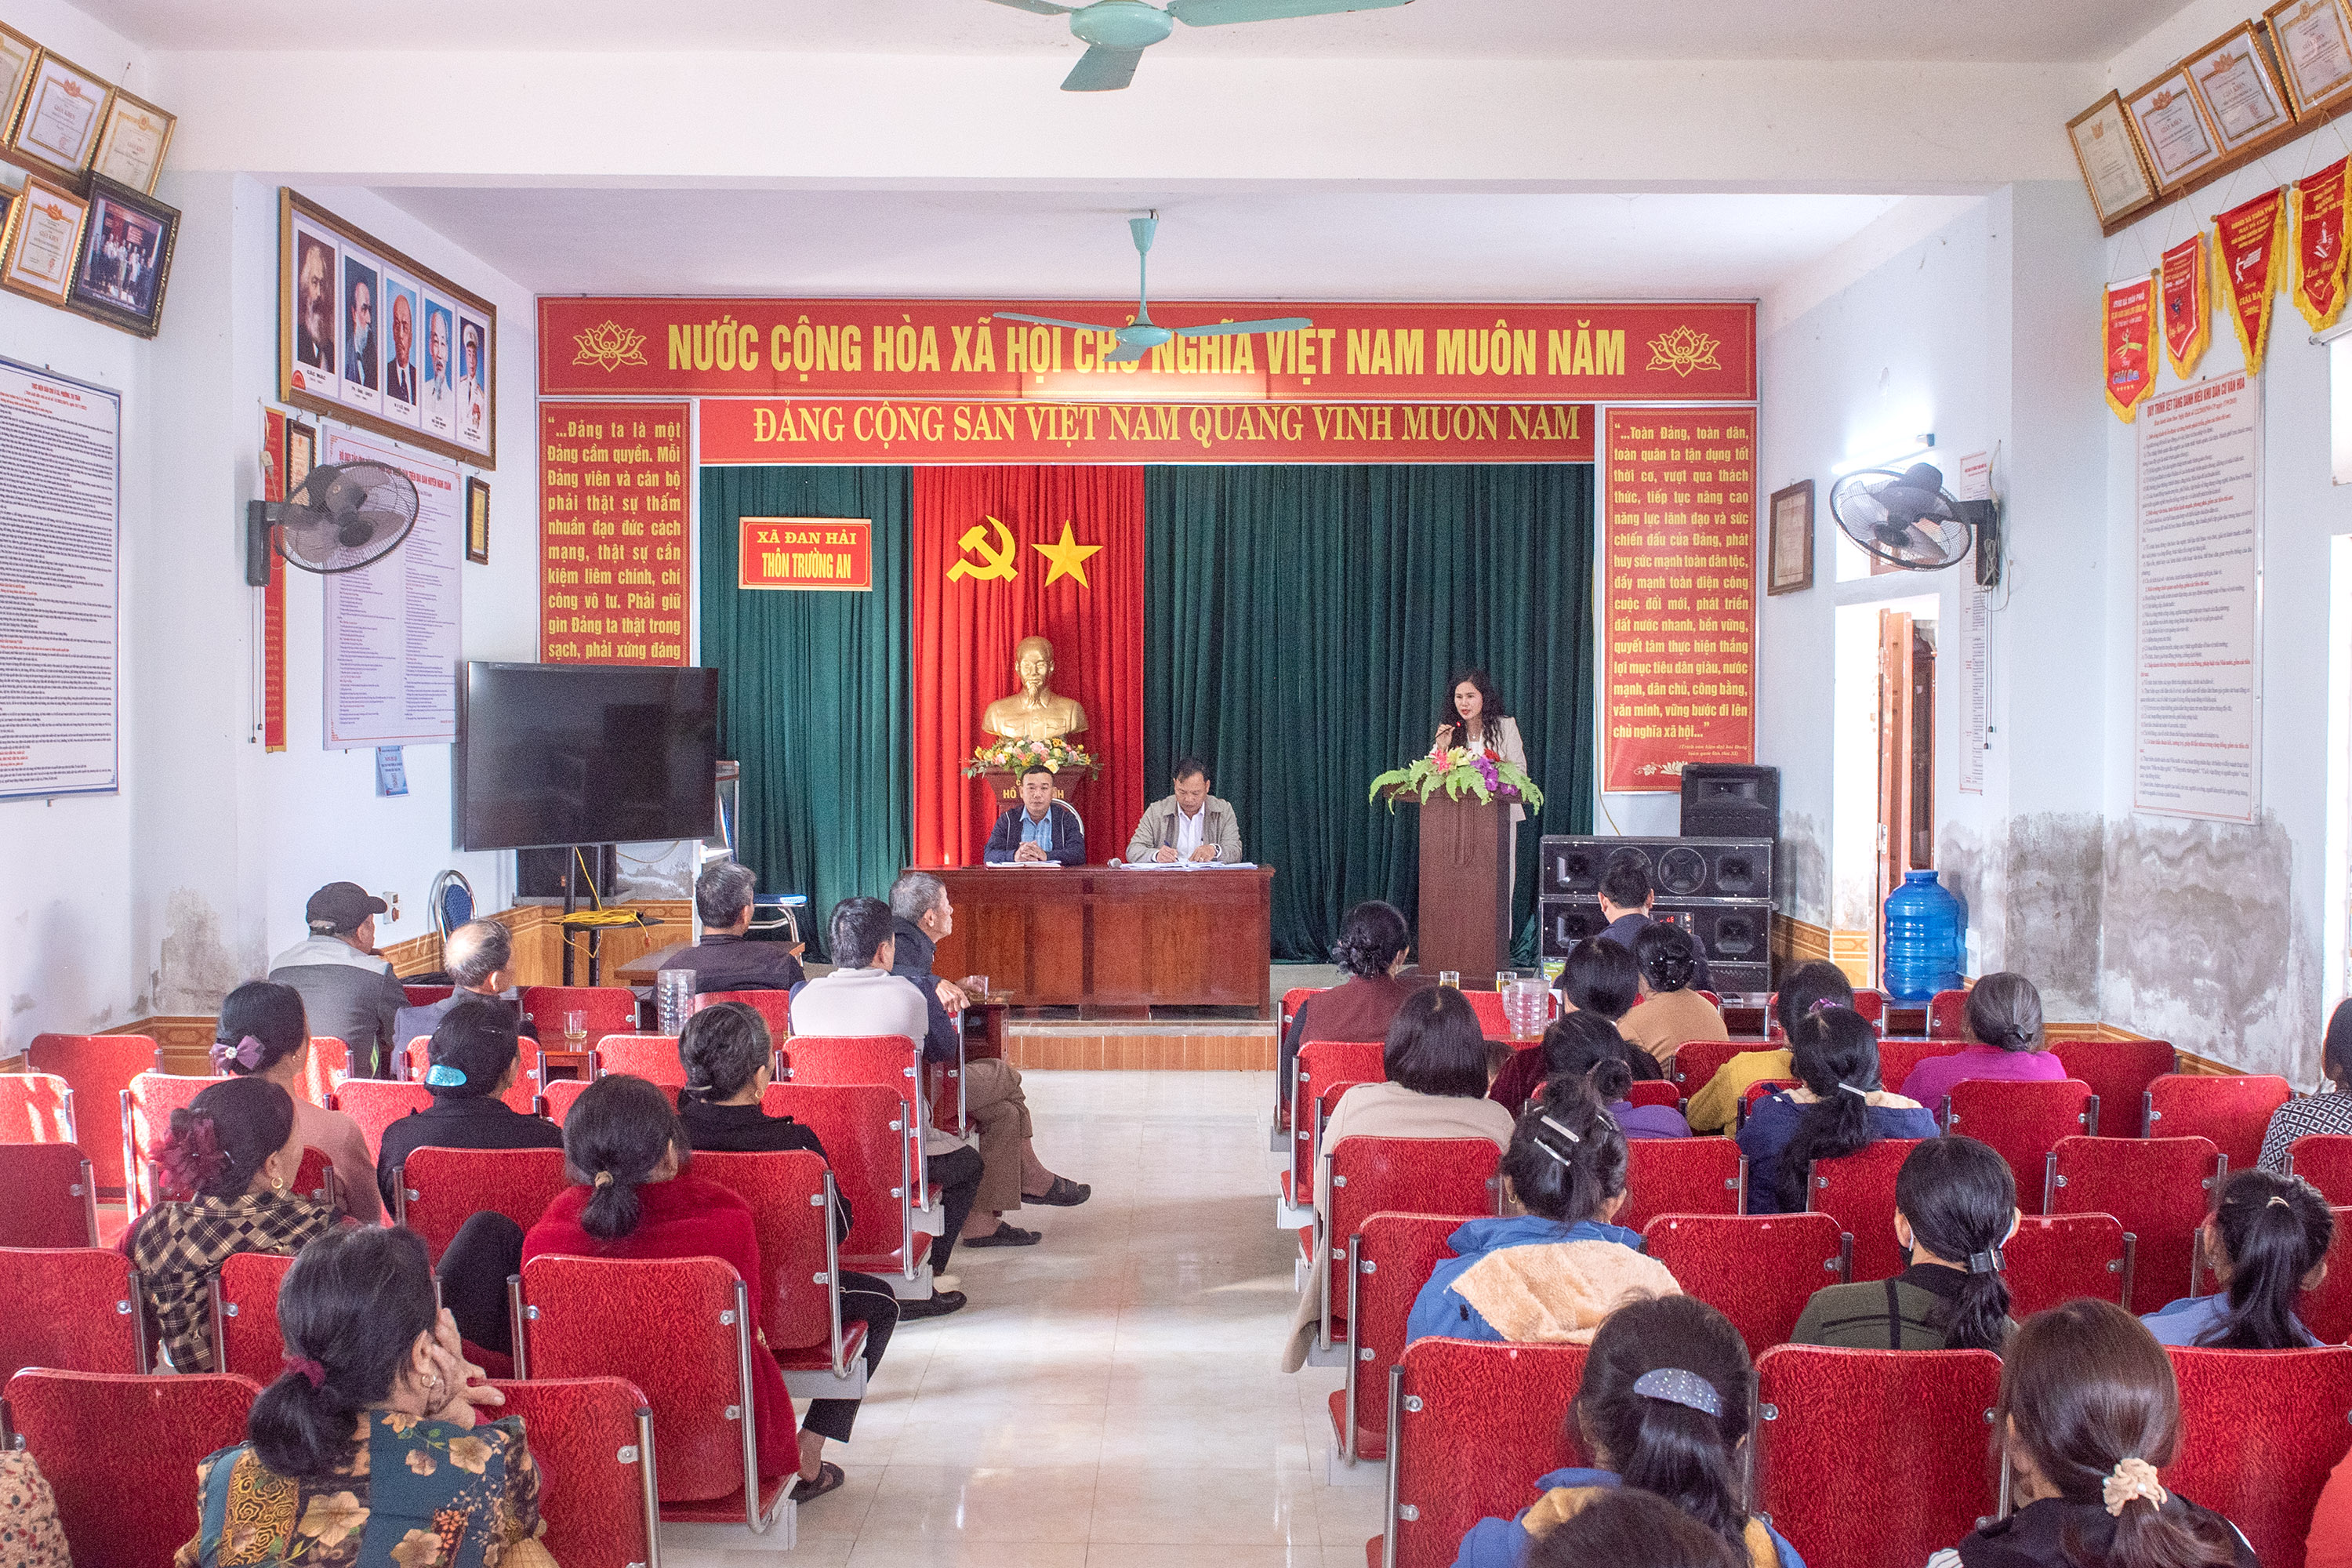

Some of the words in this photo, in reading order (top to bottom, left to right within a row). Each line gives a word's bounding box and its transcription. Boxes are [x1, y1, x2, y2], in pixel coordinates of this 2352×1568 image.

[669, 315, 759, 372] NƯỚC
[771, 316, 862, 382] CỘNG
[873, 315, 940, 372] HÒA
[951, 317, 996, 372] XÃ
[1007, 322, 1061, 383] HỘI
[1266, 323, 1336, 385] VIỆT
[1346, 328, 1425, 376] NAM
[1436, 320, 1537, 376] MUÔN
[1548, 319, 1625, 376] NĂM
[612, 422, 624, 437] ta
[633, 422, 646, 437] là
[655, 422, 681, 441] một
[753, 400, 845, 442] ĐẢNG
[854, 401, 945, 449] CỘNG
[1109, 406, 1181, 441] NAM
[1189, 406, 1304, 448] QUANG
[1312, 406, 1393, 441] VINH
[1661, 426, 1690, 440] Đảng,
[1697, 426, 1719, 439] toàn
[1726, 426, 1749, 440] dân,
[548, 444, 578, 463] Đảng
[583, 444, 608, 462] cầm
[613, 444, 652, 464] quyền.
[657, 443, 680, 462] Mỗi
[1614, 448, 1636, 460] toàn
[1641, 448, 1666, 462] quân
[1671, 449, 1680, 460] ta
[1686, 448, 1700, 463] tận
[1706, 448, 1730, 463] dụng
[1735, 445, 1749, 460] tốt
[548, 468, 578, 488] Đảng
[585, 470, 610, 486] viên
[617, 470, 630, 486] và
[637, 470, 659, 486] cán
[666, 470, 680, 490] bộ
[1614, 470, 1634, 481] thời
[1641, 472, 1657, 483] cơ,
[1664, 471, 1686, 485] vượt
[1693, 472, 1712, 483] qua
[1719, 470, 1748, 481] thách
[549, 492, 578, 512] phải
[587, 495, 614, 514] thật
[622, 497, 638, 514] sự
[647, 492, 681, 511] thấm
[1614, 491, 1640, 504] thức,
[1647, 489, 1668, 504] tiếp
[1674, 492, 1690, 506] tục
[1697, 492, 1722, 504] nâng
[1730, 492, 1748, 503] cao
[549, 517, 585, 535] nhuần
[593, 520, 614, 539] đạo
[622, 520, 644, 535] đức
[651, 520, 681, 535] cách
[1614, 512, 1639, 525] năng
[1644, 513, 1659, 527] lực
[1664, 512, 1686, 524] lãnh
[1691, 512, 1709, 527] đạo
[1714, 512, 1726, 524] và
[1730, 512, 1748, 524] sức
[757, 530, 780, 543] XÃ
[785, 532, 821, 544] ĐAN
[826, 529, 856, 544] HẢI
[1614, 532, 1642, 546] chiến
[1647, 532, 1666, 546] đấu
[1670, 532, 1688, 546] của
[1693, 532, 1721, 547] Đảng,
[1726, 533, 1748, 547] phát
[549, 546, 589, 563] mạng,
[598, 544, 624, 563] thật
[633, 546, 648, 563] sự
[656, 542, 681, 560] cần
[762, 547, 789, 577] THÔN
[793, 547, 833, 578] TRƯỜNG
[836, 554, 851, 578] AN
[1614, 555, 1632, 568] huy
[1635, 555, 1652, 567] sức
[1654, 555, 1682, 569] mạnh
[1685, 555, 1706, 567] toàn
[1708, 555, 1726, 567] dân
[1730, 555, 1748, 570] tộc,
[549, 568, 578, 587] kiệm
[585, 568, 612, 584] liêm
[618, 568, 655, 586] chính,
[662, 568, 680, 585] chí
[1614, 573, 1632, 590] đẩy
[1637, 576, 1665, 591] mạnh
[1670, 576, 1692, 588] toàn
[1697, 576, 1719, 591] diện
[1723, 576, 1748, 590] công
[549, 592, 578, 610] công
[585, 592, 598, 608] vô
[605, 593, 620, 608] tư.
[628, 591, 655, 608] Phải
[662, 593, 681, 611] giữ
[1614, 598, 1639, 612] cuộc
[1646, 595, 1661, 609] đổi
[1668, 597, 1690, 612] mới,
[1697, 597, 1719, 611] phát
[1725, 595, 1748, 609] triển
[549, 617, 567, 634] gìn
[572, 615, 601, 634] Đảng
[606, 618, 618, 633] ta
[622, 618, 645, 637] thật
[649, 619, 681, 635] trong
[1614, 616, 1631, 631] đất
[1634, 619, 1658, 631] nước
[1662, 619, 1696, 632] nhanh,
[1699, 617, 1718, 631] bền
[1721, 619, 1748, 632] vững,
[549, 641, 580, 660] sạch,
[586, 640, 612, 658] phải
[617, 641, 646, 659] xứng
[651, 641, 681, 659] đáng
[1614, 638, 1642, 653] quyết
[1646, 641, 1664, 652] tâm
[1668, 641, 1690, 655] thực
[1694, 641, 1716, 655] hiện
[1720, 637, 1748, 653] thắng
[1614, 662, 1627, 677] lợi
[1629, 663, 1651, 677] mục
[1653, 662, 1673, 673] tiêu
[1675, 662, 1693, 673] dân
[1696, 662, 1720, 675] giàu,
[1723, 662, 1748, 673] nước
[1613, 683, 1645, 698] mạnh,
[1647, 683, 1666, 695] dân
[1668, 681, 1690, 696] chủ,
[1693, 683, 1717, 696] công
[1719, 680, 1748, 696] bằng,
[1613, 704, 1632, 716] văn
[1635, 704, 1662, 717] minh,
[1665, 704, 1690, 717] vững
[1692, 704, 1716, 716] bước
[1719, 704, 1729, 716] đi
[1731, 704, 1748, 716] lên
[1613, 724, 1632, 738] chủ
[1634, 725, 1662, 739] nghĩa
[1664, 726, 1676, 738] xã
[1003, 786, 1017, 798] HỒ
